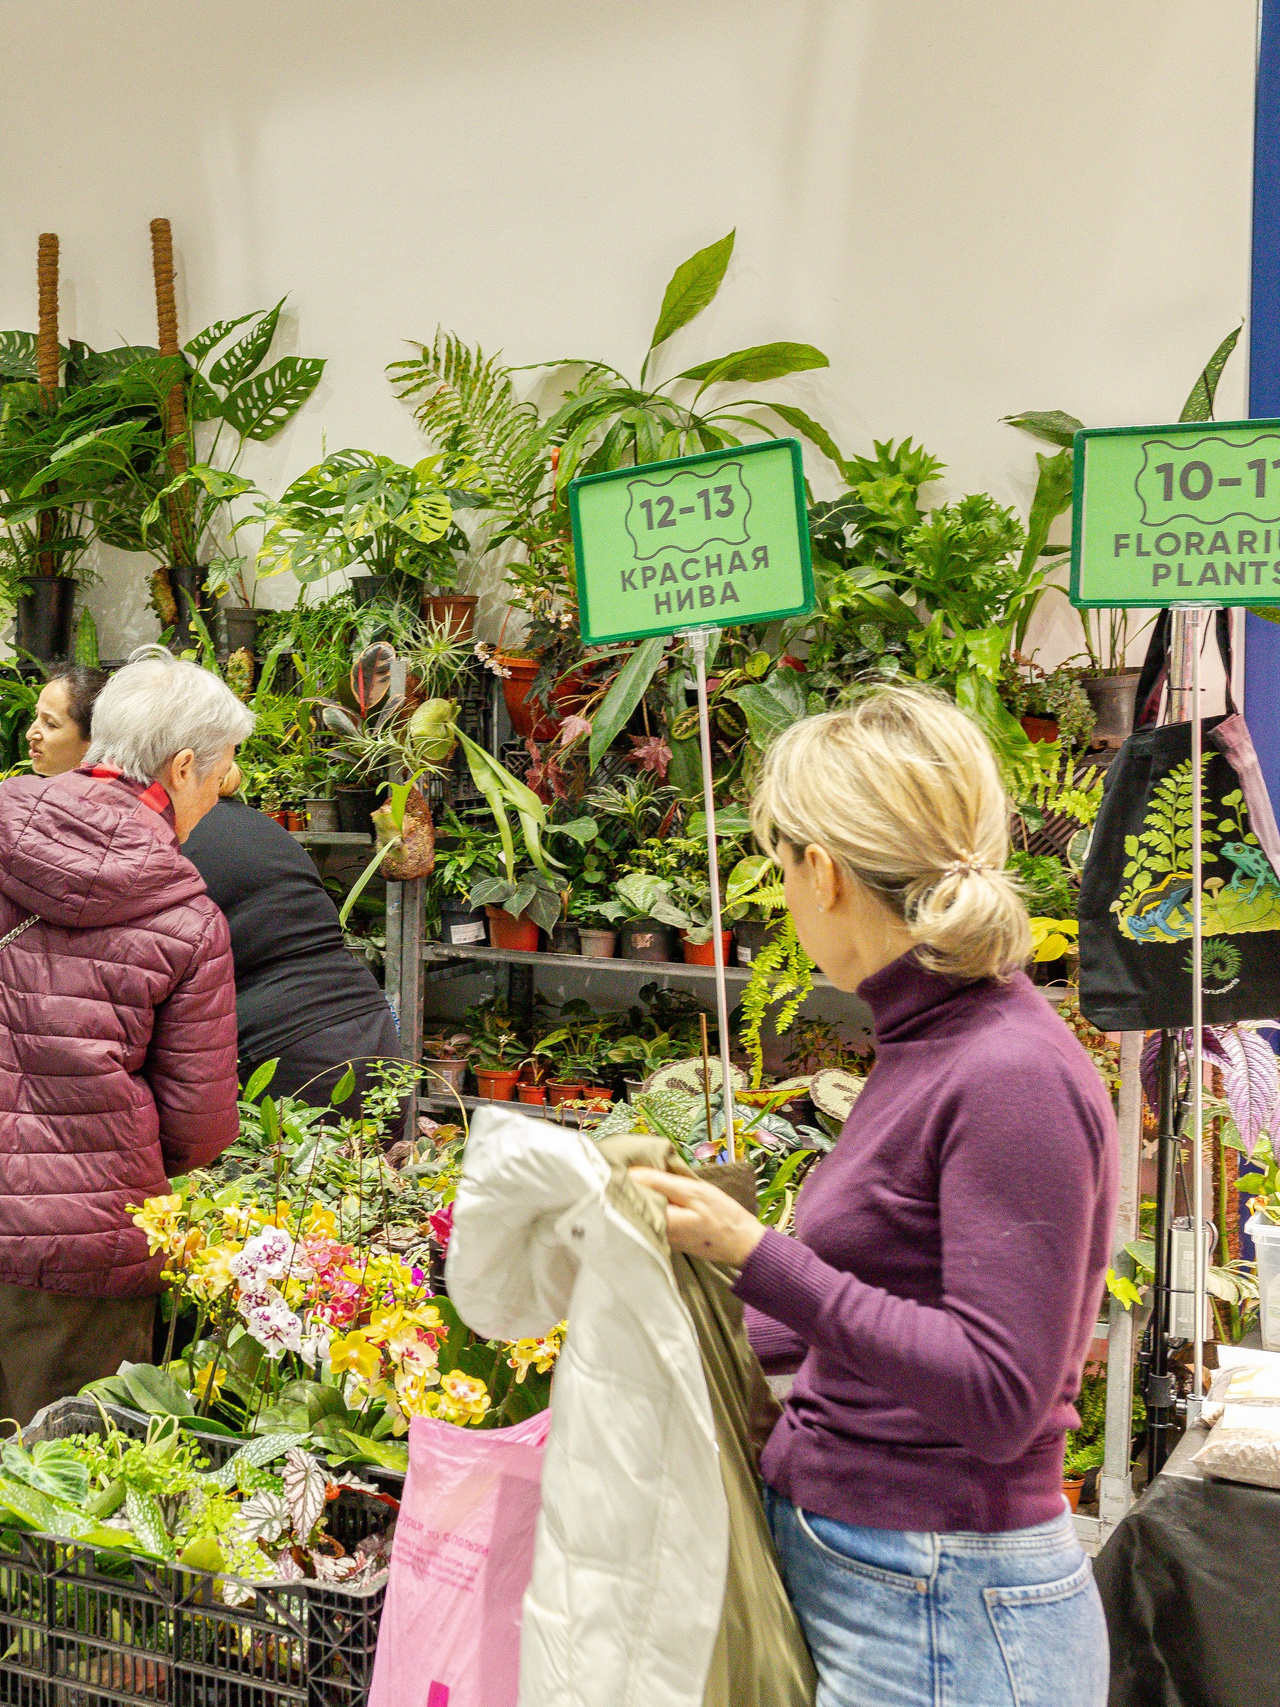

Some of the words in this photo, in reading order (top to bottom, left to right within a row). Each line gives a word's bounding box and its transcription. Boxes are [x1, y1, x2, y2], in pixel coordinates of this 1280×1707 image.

[639, 484, 735, 531] 12-13
[1114, 529, 1280, 558] FLORARI
[620, 545, 770, 592] КРАСНАЯ
[654, 580, 740, 615] НИВА
